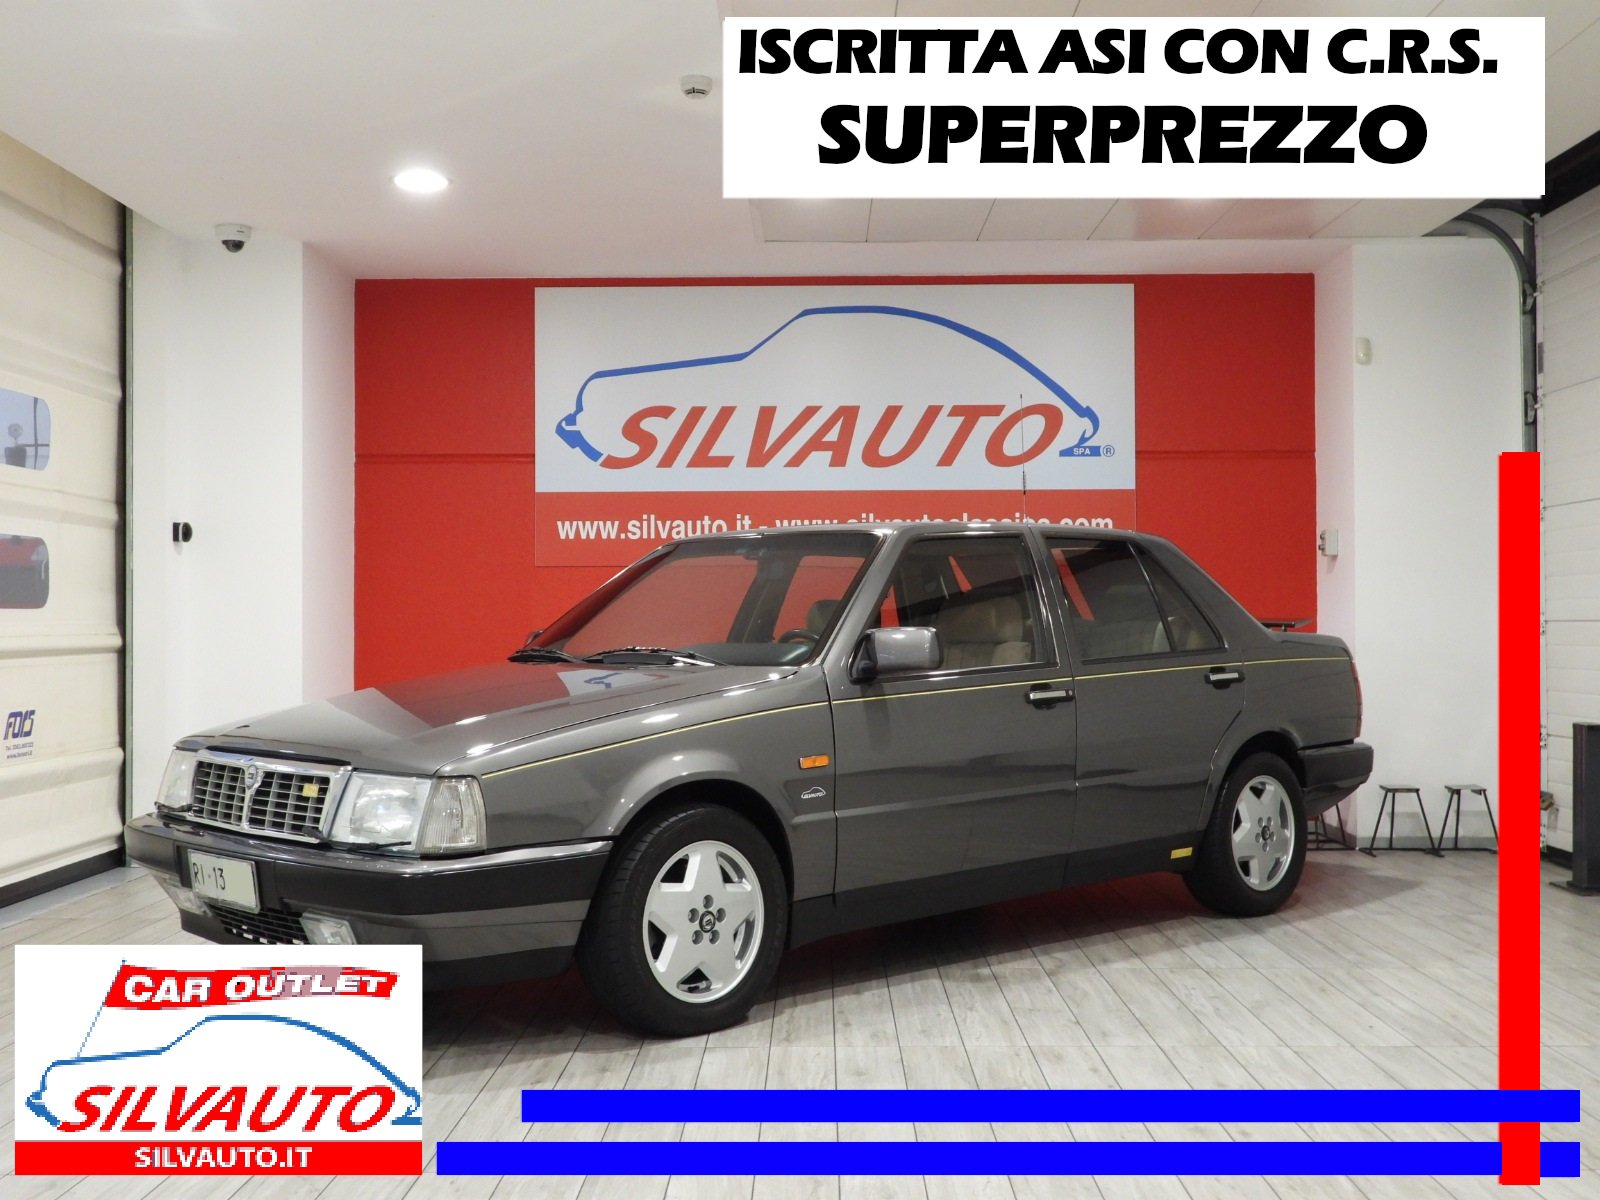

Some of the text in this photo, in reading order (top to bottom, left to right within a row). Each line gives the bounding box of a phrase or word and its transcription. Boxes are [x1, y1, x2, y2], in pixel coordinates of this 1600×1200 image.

[601, 404, 1064, 469] SILVAUTO
[1073, 447, 1091, 455] SPA
[557, 514, 751, 540] www.silvautoit
